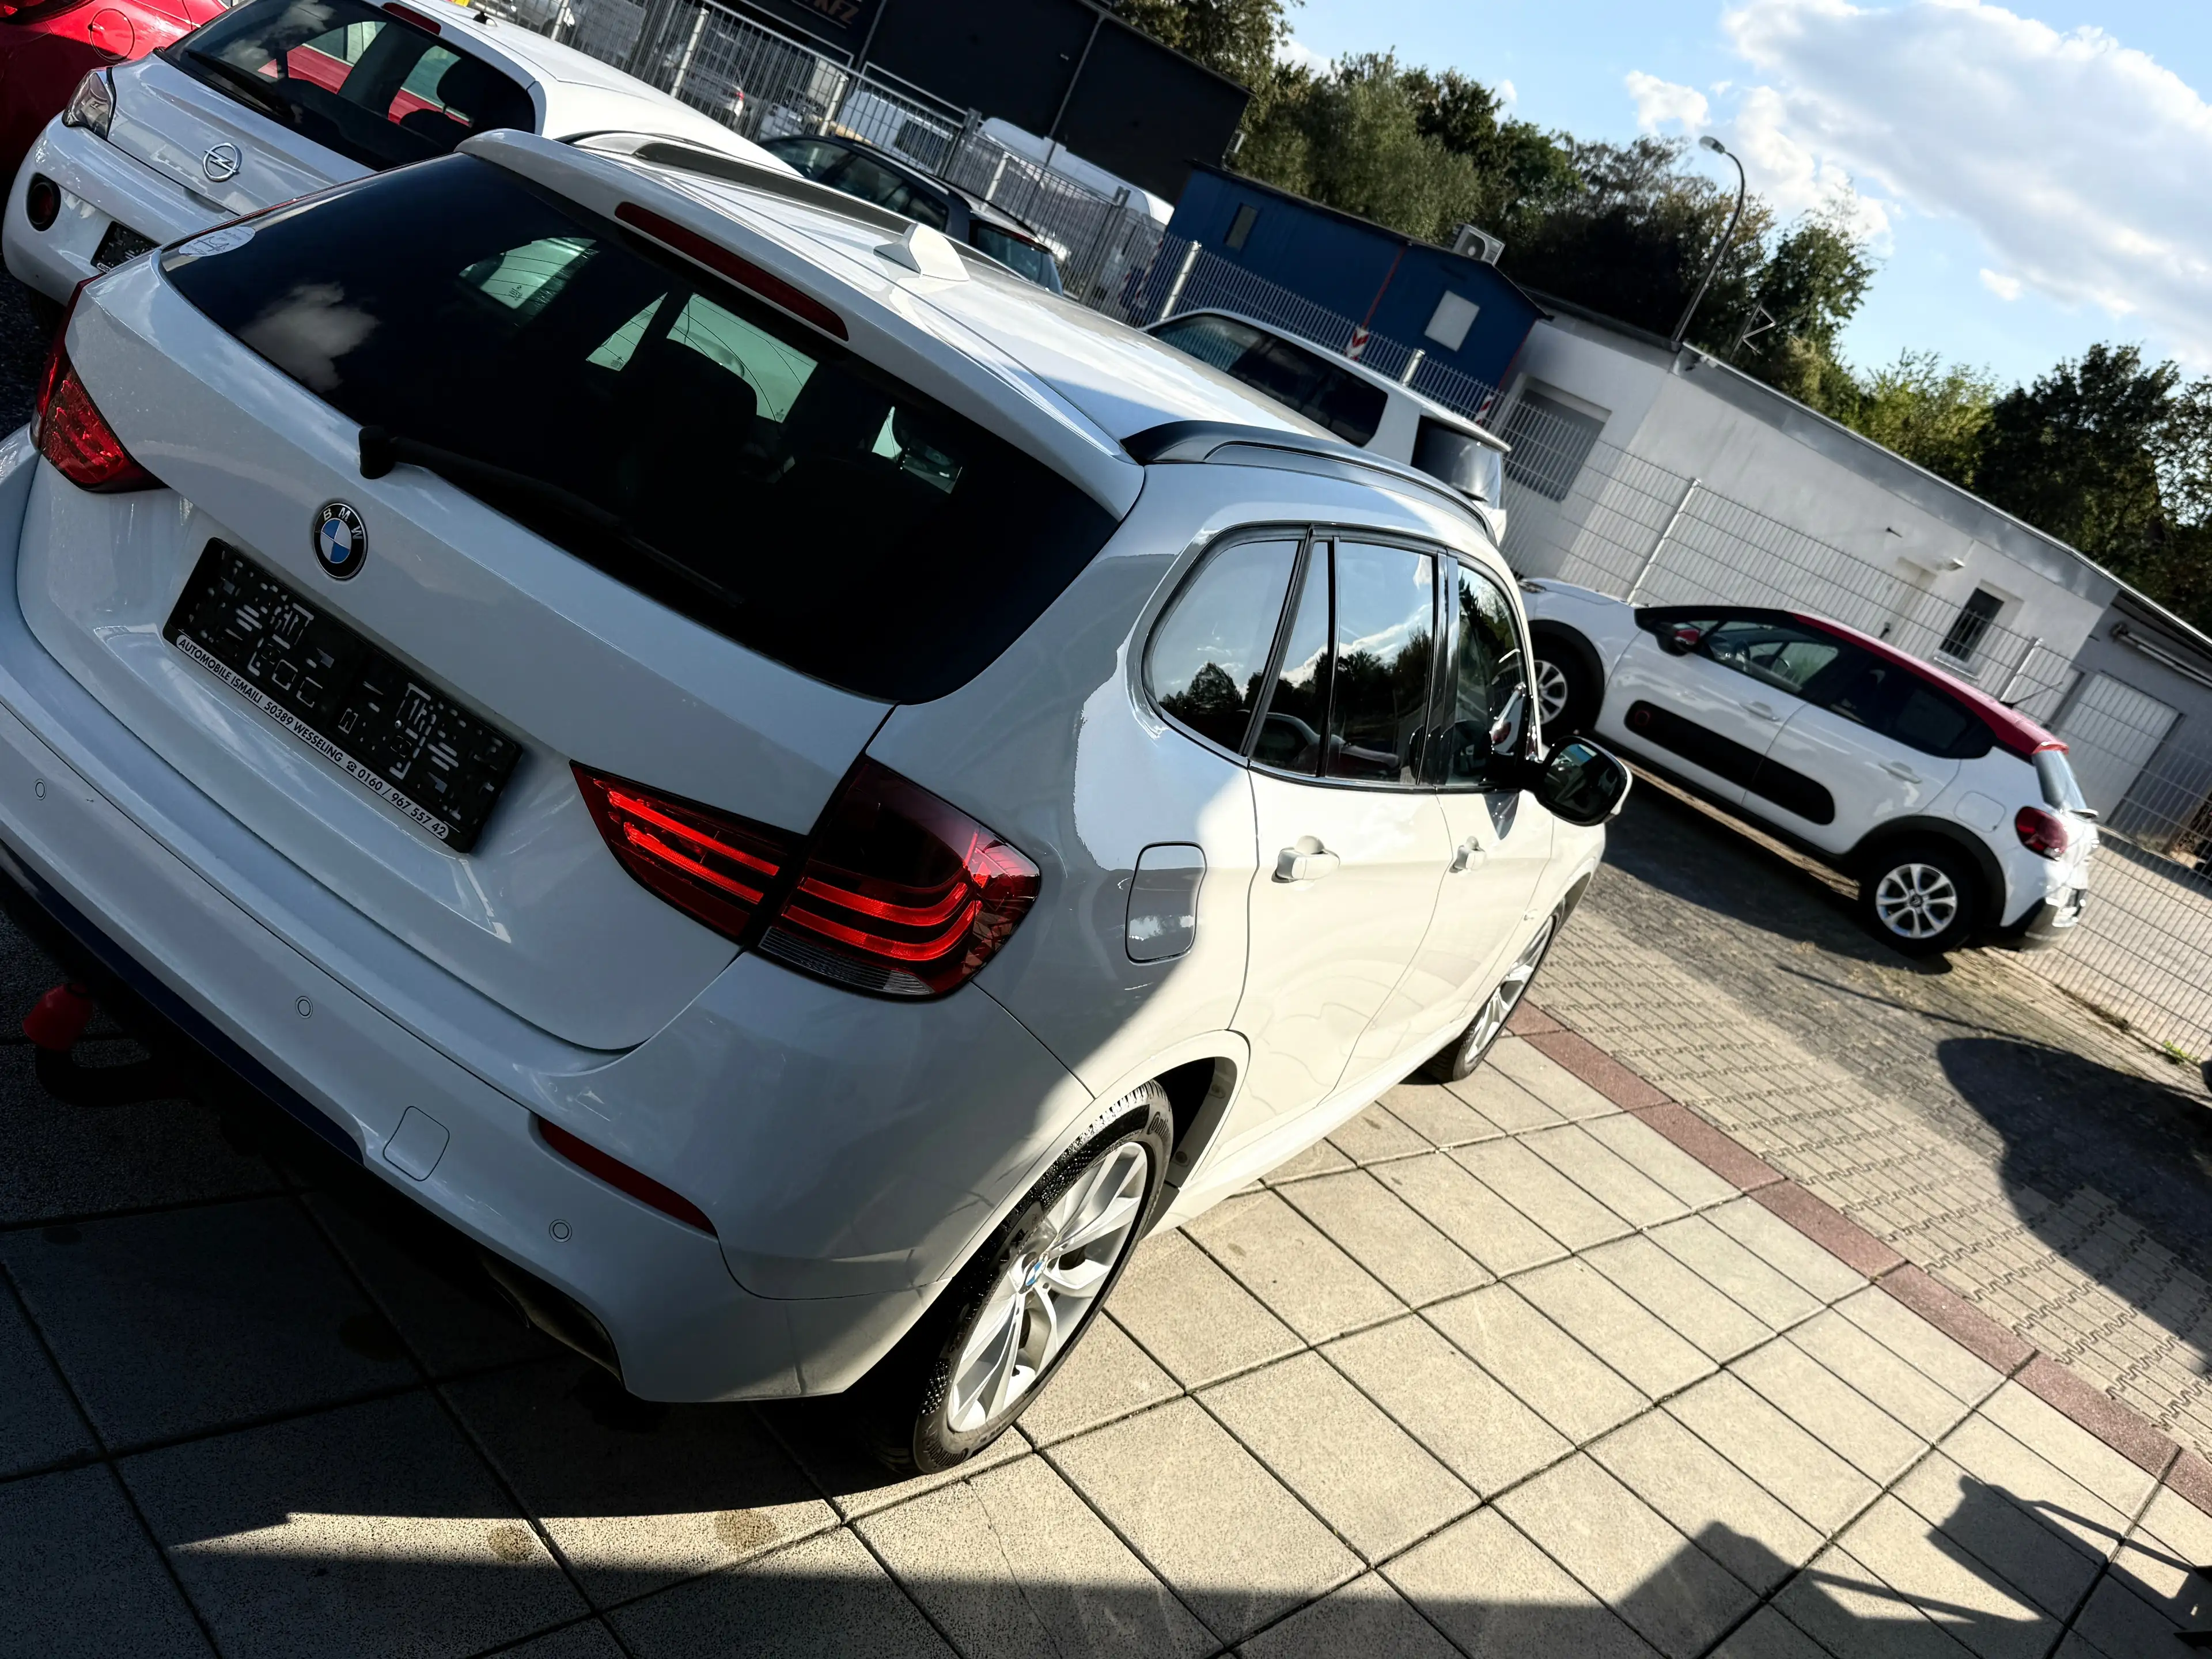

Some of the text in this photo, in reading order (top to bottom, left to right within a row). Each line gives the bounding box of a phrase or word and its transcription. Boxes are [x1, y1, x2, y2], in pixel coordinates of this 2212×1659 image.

[323, 506, 363, 540] BMW
[179, 639, 447, 837] AUTOMOBILE ISMAILI 50389 WESSELING 0160 / 967 557 42
